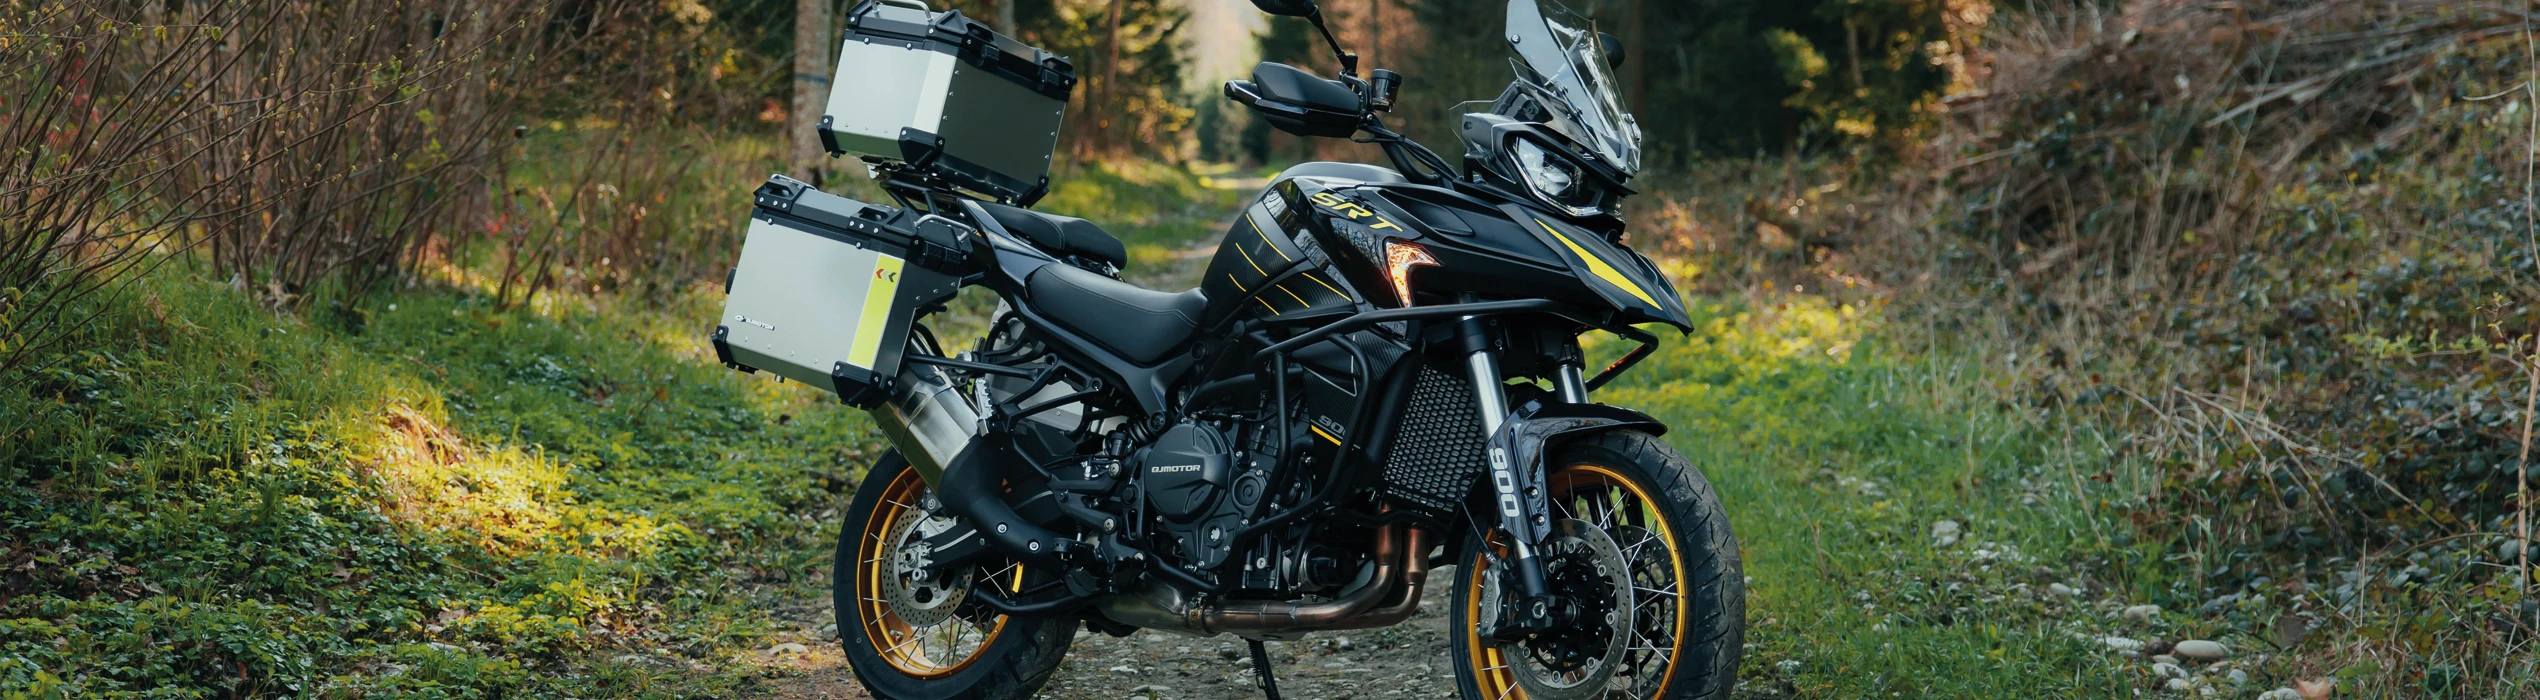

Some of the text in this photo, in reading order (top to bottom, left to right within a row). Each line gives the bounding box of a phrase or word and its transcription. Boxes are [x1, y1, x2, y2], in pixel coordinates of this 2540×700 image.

[1310, 192, 1403, 232] SRT
[1318, 414, 1346, 436] 90
[1151, 464, 1201, 473] QJMOTOR
[1489, 447, 1520, 517] 900
